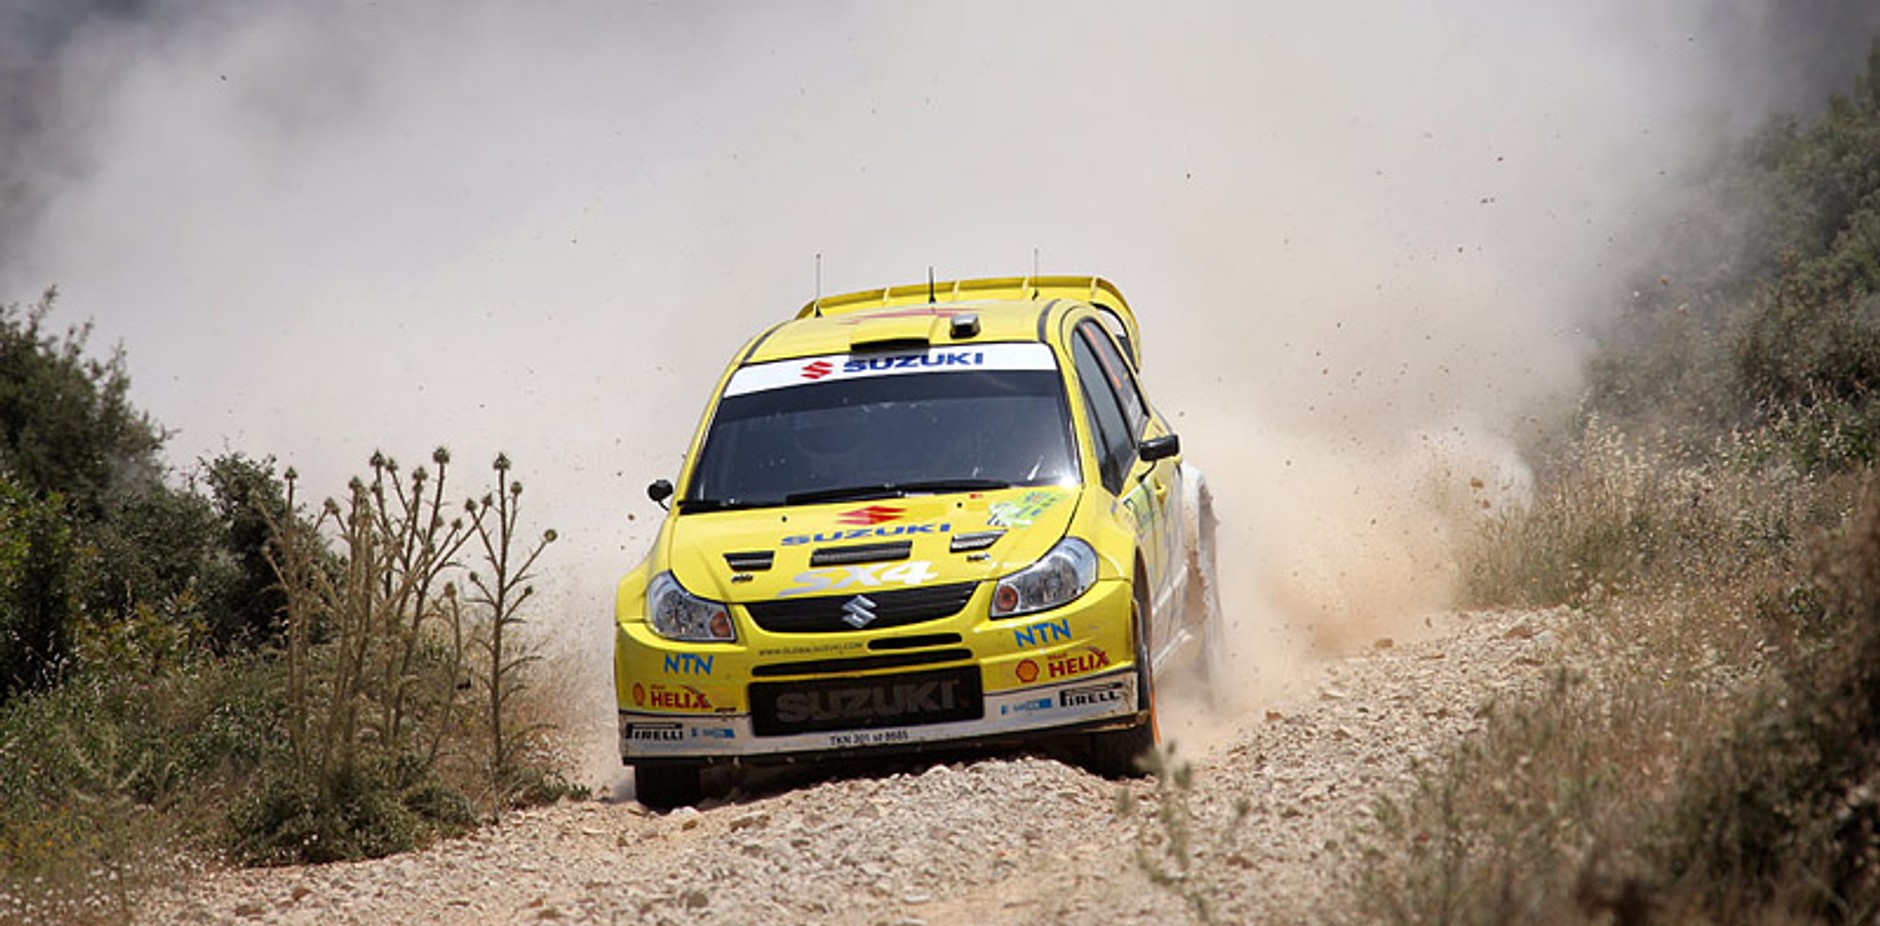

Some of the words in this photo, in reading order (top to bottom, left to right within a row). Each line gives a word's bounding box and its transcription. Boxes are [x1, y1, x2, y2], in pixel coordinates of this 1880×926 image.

[843, 352, 984, 373] SUZUKI
[780, 522, 951, 547] SUZUKI
[777, 560, 939, 598] SX4
[1014, 619, 1072, 648] NTN
[664, 653, 714, 676] NTN
[1048, 651, 1109, 678] HELIX
[650, 690, 711, 709] HELIX
[776, 681, 955, 723] SUZUKI
[625, 722, 683, 739] PIRELLI
